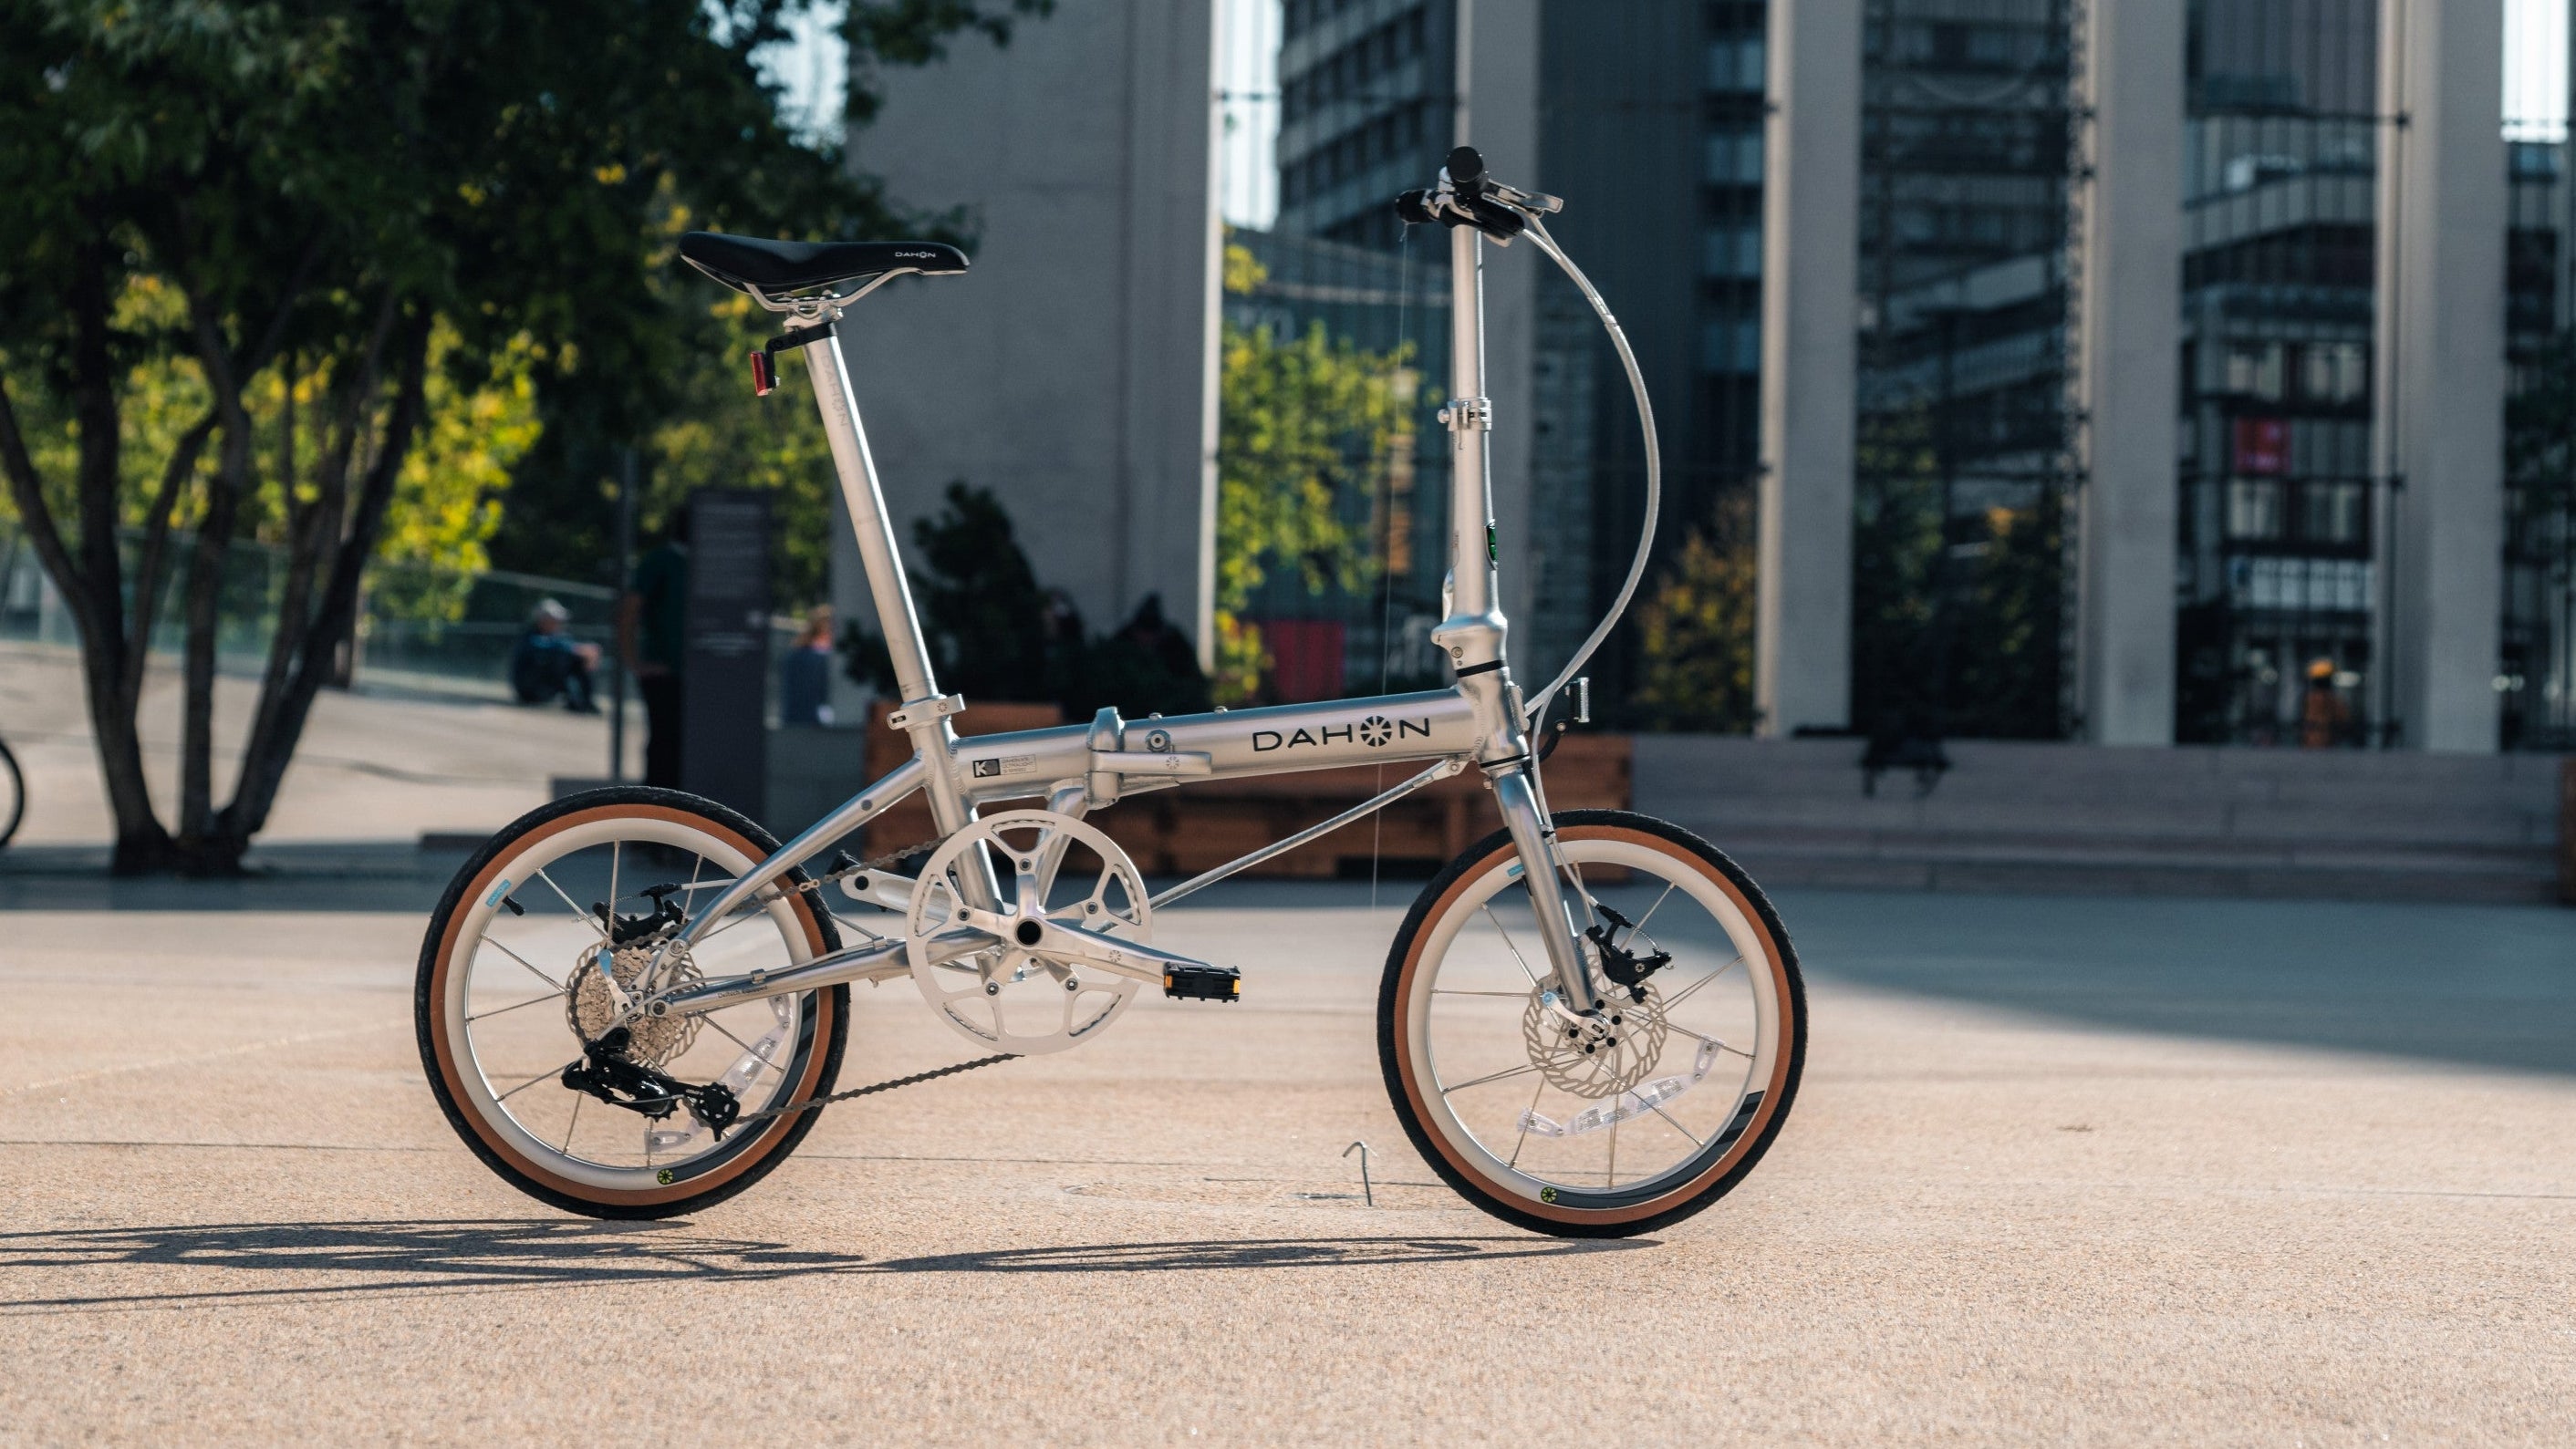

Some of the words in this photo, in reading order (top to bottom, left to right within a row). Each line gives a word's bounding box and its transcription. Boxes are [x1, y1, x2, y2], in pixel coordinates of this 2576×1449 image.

[895, 251, 936, 259] DAHON
[821, 355, 848, 427] DAHON
[1252, 715, 1429, 751] DAHON
